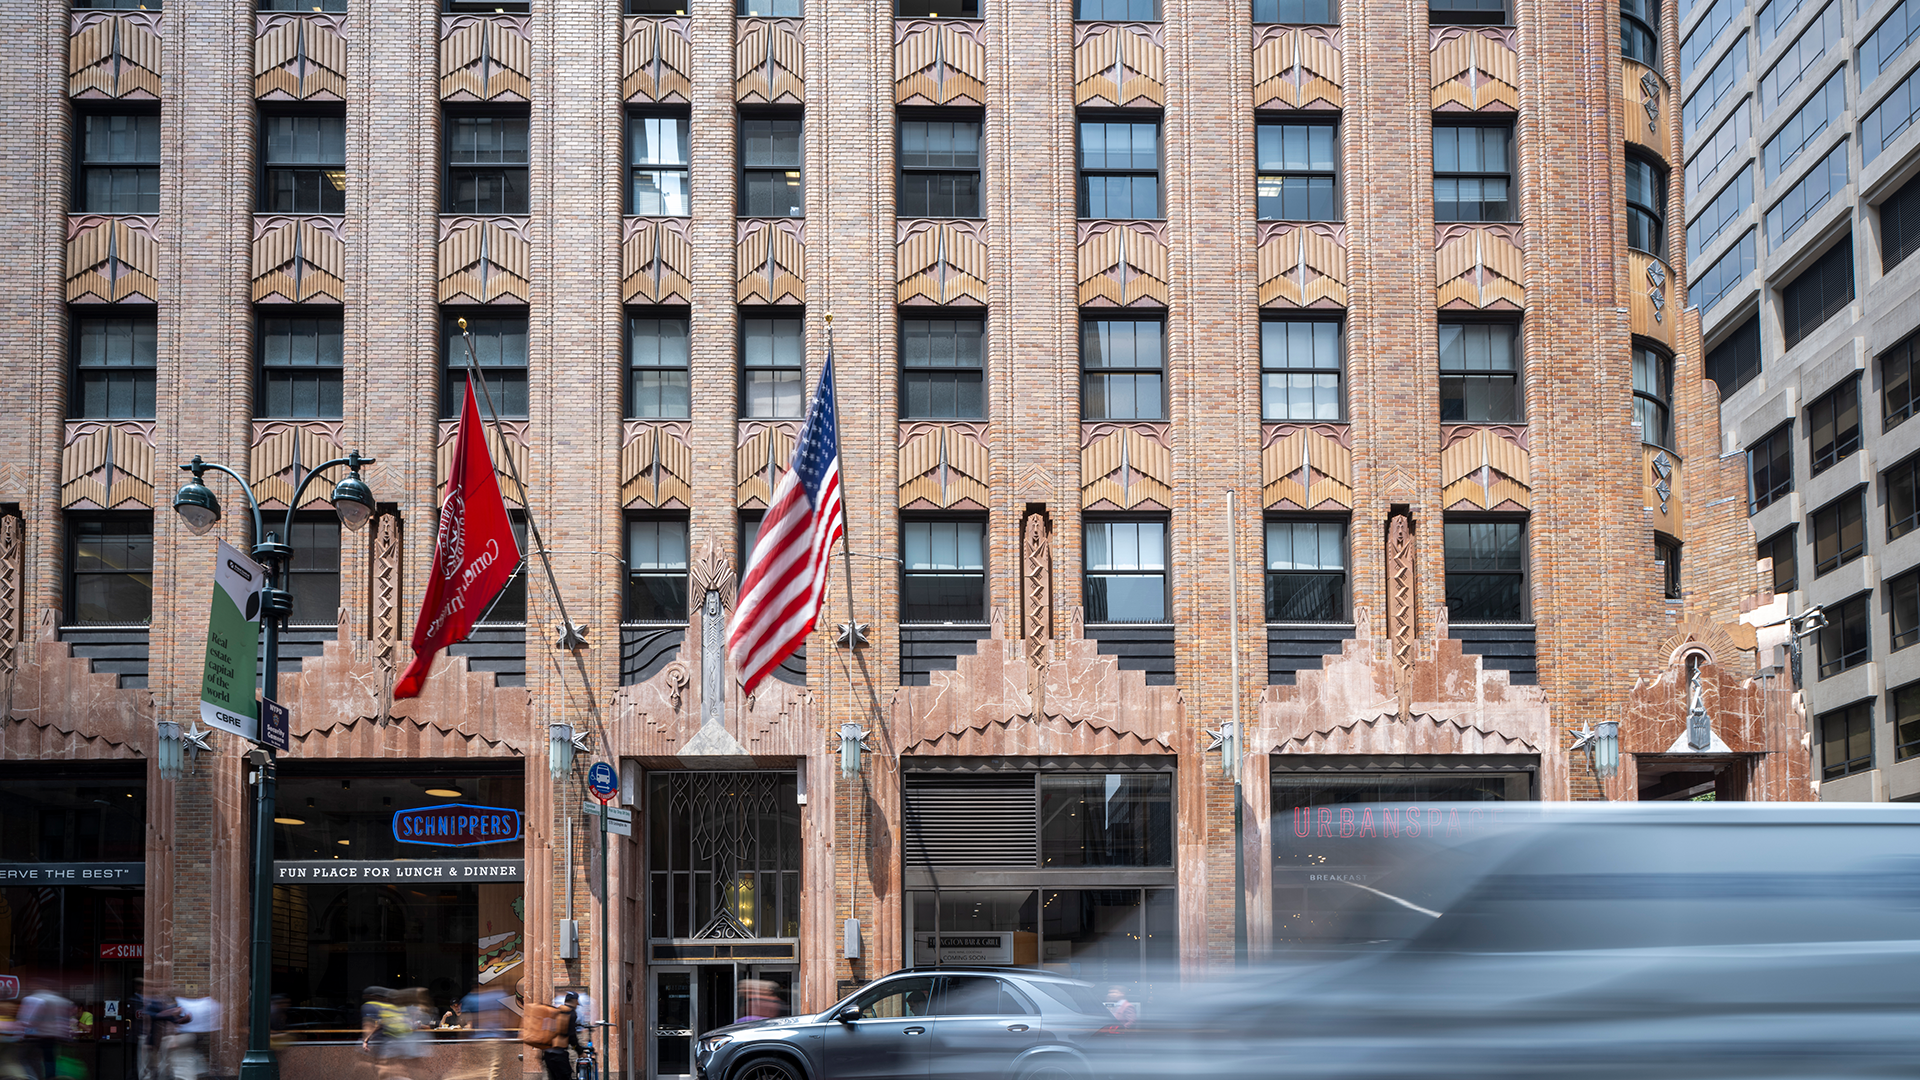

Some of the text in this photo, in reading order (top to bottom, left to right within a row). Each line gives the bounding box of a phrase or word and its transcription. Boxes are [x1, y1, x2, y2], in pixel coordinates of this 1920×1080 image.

[212, 632, 228, 649] Real
[210, 647, 232, 664] estate
[208, 660, 234, 678] capital
[207, 673, 230, 690] of the
[206, 687, 230, 703] world
[269, 704, 283, 715] NYPD
[216, 711, 241, 728] CBRE
[267, 724, 285, 738] Security
[267, 732, 285, 744] Camera
[597, 790, 616, 799] STANDING
[402, 814, 512, 836] SCHNIPPERS
[1294, 806, 1505, 838] URBANSPACE
[45, 869, 75, 878] THE
[279, 866, 517, 878] FUN PLACE FOR LUNCH & DINNER
[711, 922, 735, 939] 570
[964, 938, 975, 946] BAR
[975, 938, 981, 946] &
[981, 938, 999, 946] GRILL
[107, 1002, 116, 1012] A
